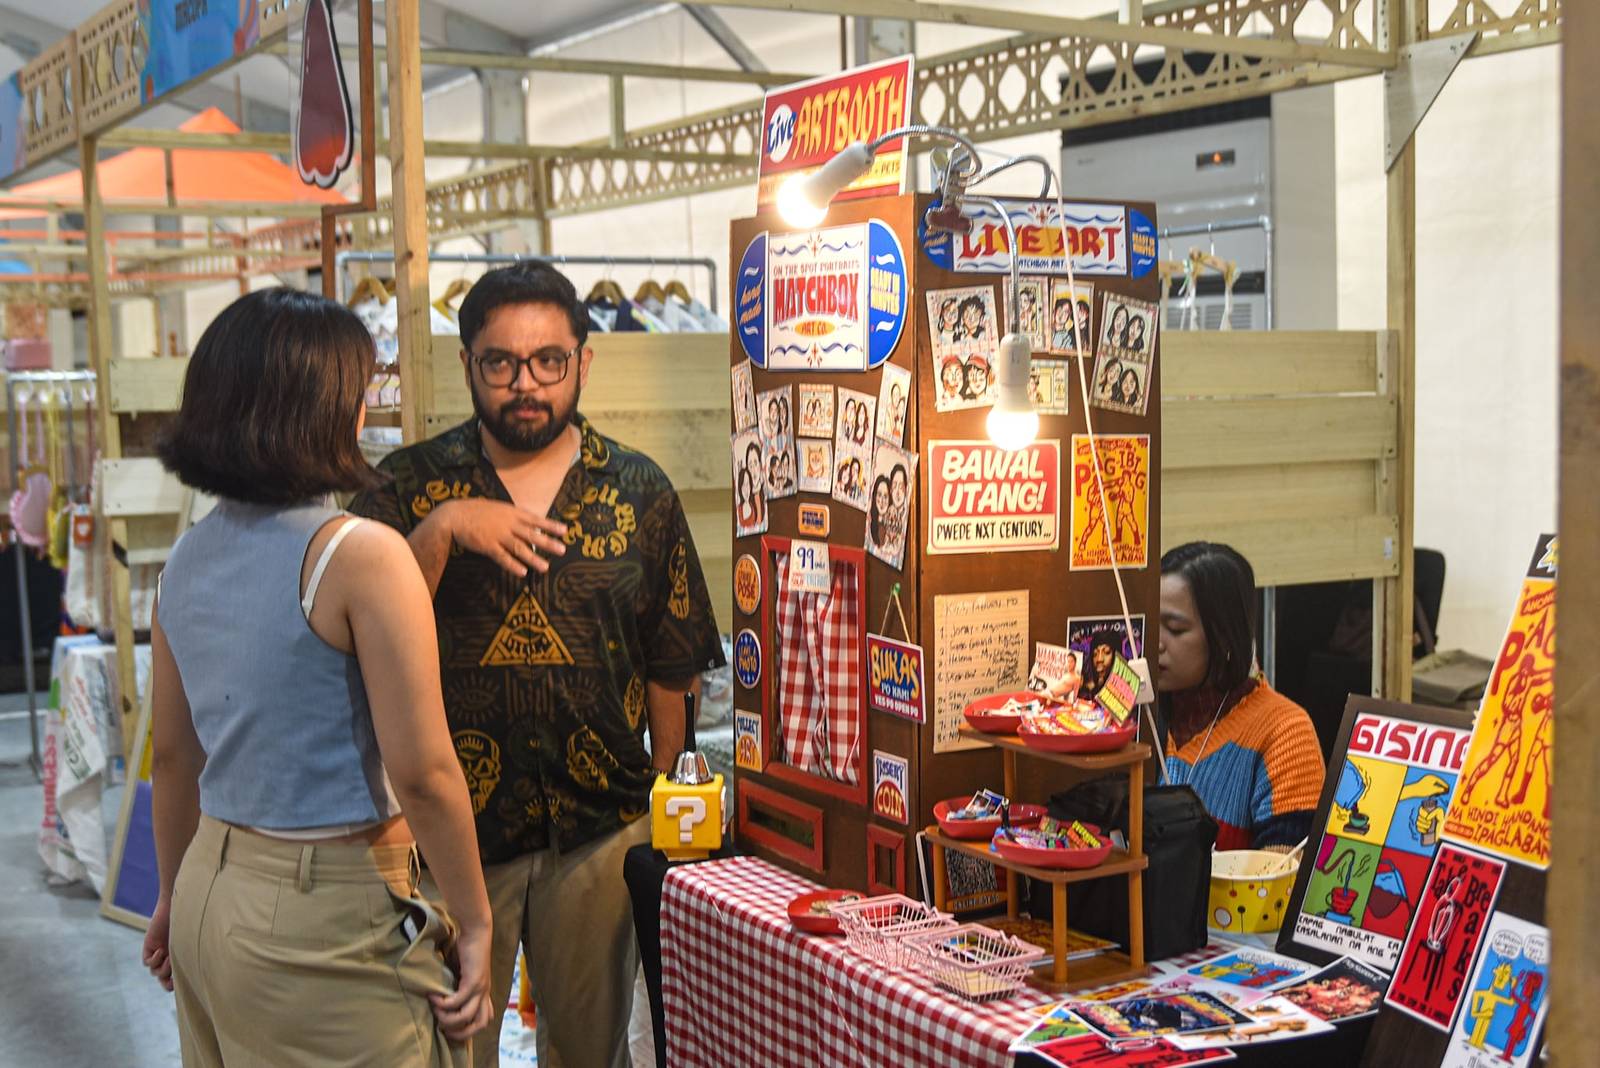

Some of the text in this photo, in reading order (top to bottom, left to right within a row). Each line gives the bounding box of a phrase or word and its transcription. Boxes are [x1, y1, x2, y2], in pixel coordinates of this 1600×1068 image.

[793, 75, 905, 160] ARTBOOTH
[1052, 227, 1124, 263] ART
[773, 273, 859, 328] MATCHBOX
[942, 449, 1044, 481] BAWAL
[942, 481, 1048, 515] UTANG!
[936, 521, 972, 541] PWEDE
[975, 520, 996, 540] NXT
[797, 547, 815, 571] 99
[871, 644, 920, 699] BUKAS
[881, 682, 891, 695] PO
[737, 715, 760, 744] COLLECT
[876, 757, 903, 790] INSERT
[877, 785, 902, 818] COIN
[1449, 804, 1463, 822] NA
[1467, 805, 1500, 827] HINDI
[1366, 946, 1384, 957] ANG
